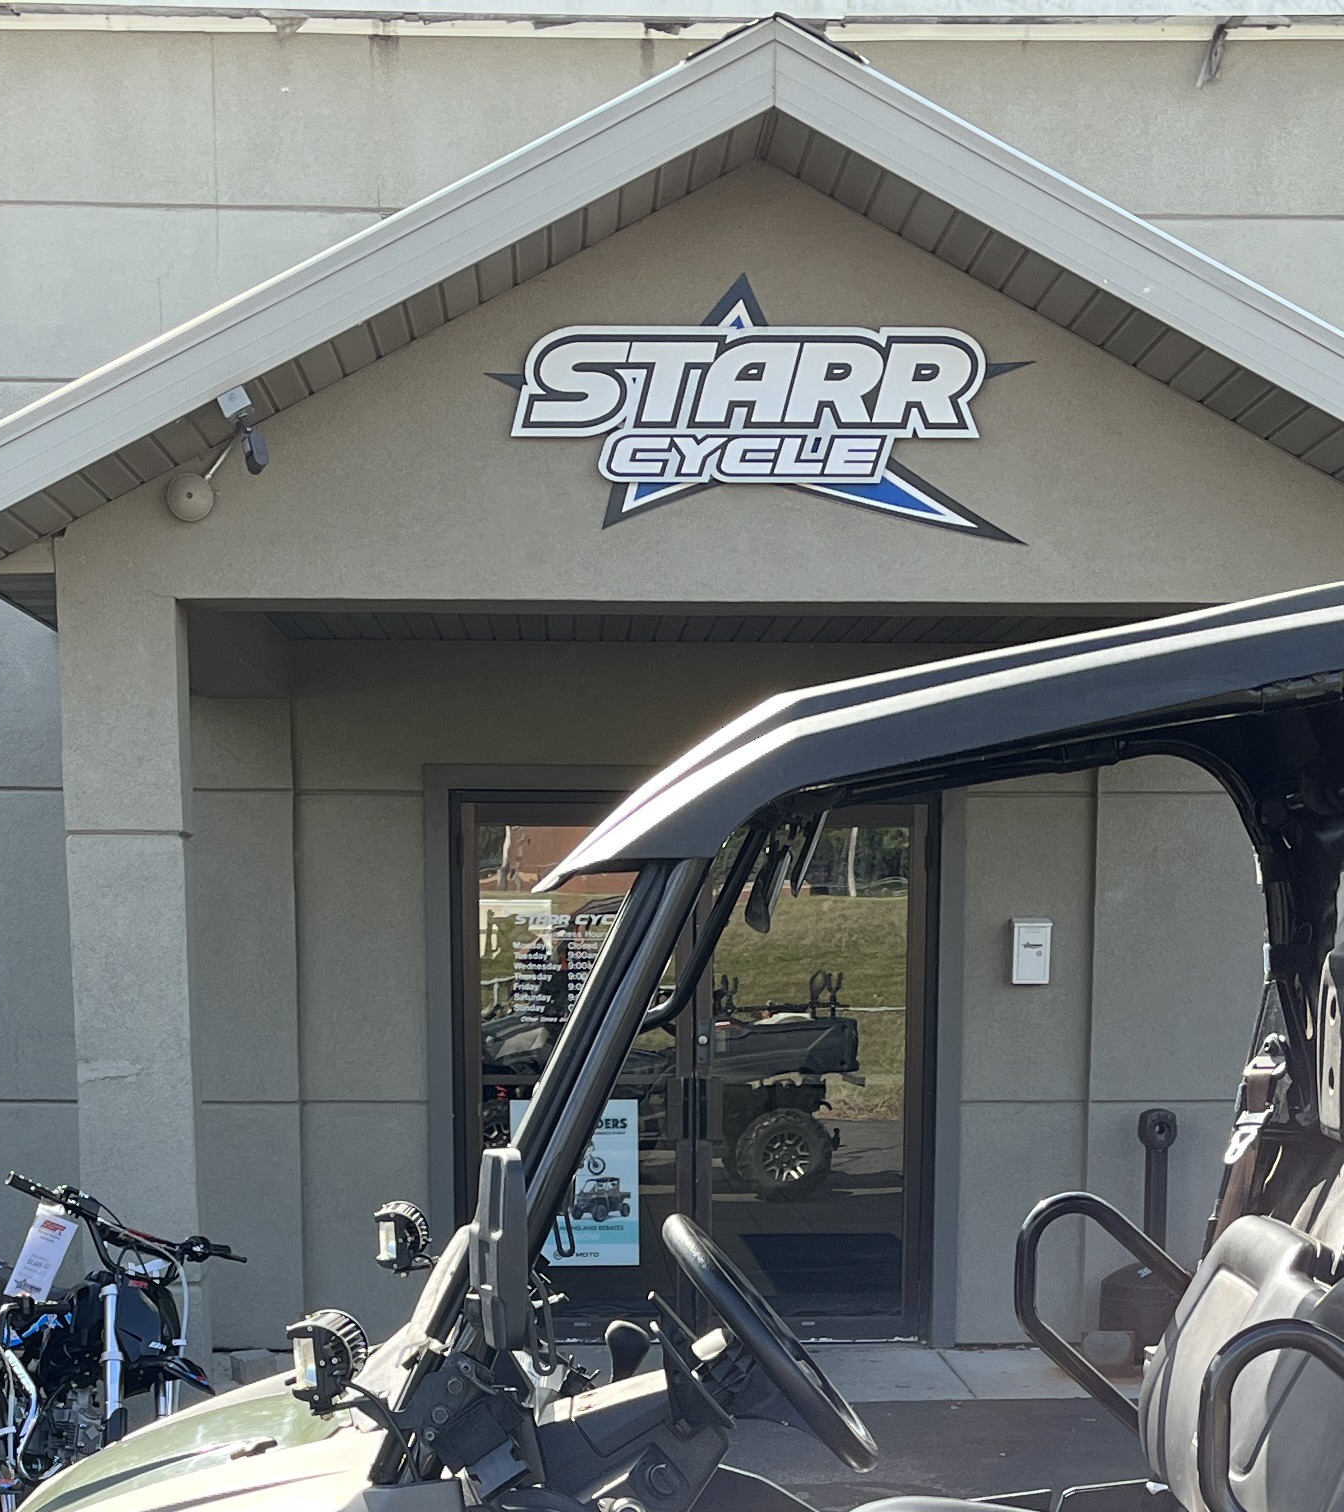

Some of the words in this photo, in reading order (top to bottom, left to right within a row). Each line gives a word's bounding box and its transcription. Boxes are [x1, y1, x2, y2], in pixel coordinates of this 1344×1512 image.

[524, 336, 975, 428] STARR
[608, 435, 881, 476] CYCLE
[514, 914, 572, 925] STARR
[574, 914, 616, 925] CYC
[513, 941, 546, 951] Monday
[514, 952, 548, 961] Tuesday
[513, 962, 563, 972] Wednesday
[514, 972, 553, 982] Thursday
[513, 982, 541, 992] Friday
[513, 992, 553, 1002] Saturday
[513, 1003, 545, 1013] Sunday
[596, 1118, 628, 1129] DERS
